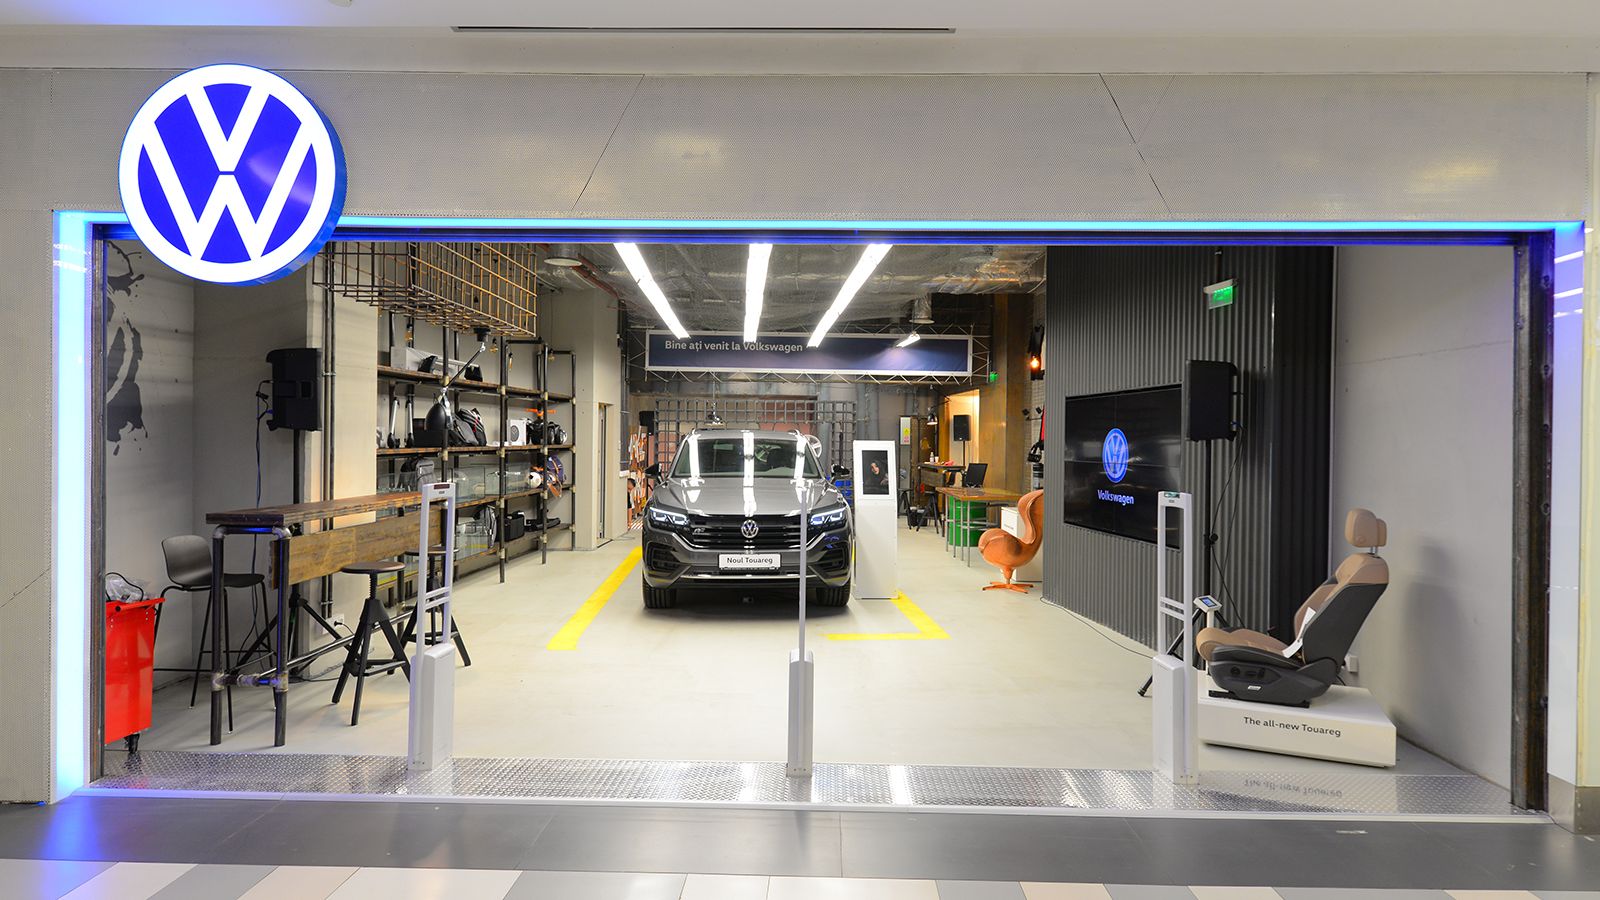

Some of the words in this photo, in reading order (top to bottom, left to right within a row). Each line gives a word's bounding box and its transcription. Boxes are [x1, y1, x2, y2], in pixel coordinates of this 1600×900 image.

[665, 340, 687, 350] Bine
[704, 341, 730, 351] venit
[731, 341, 741, 351] la
[743, 342, 803, 354] Volkswagen
[1097, 489, 1135, 506] Volkswagen
[745, 557, 773, 565] Touareg
[1243, 716, 1261, 726] The
[1263, 719, 1300, 731] all-new
[1301, 723, 1342, 738] Touareg
